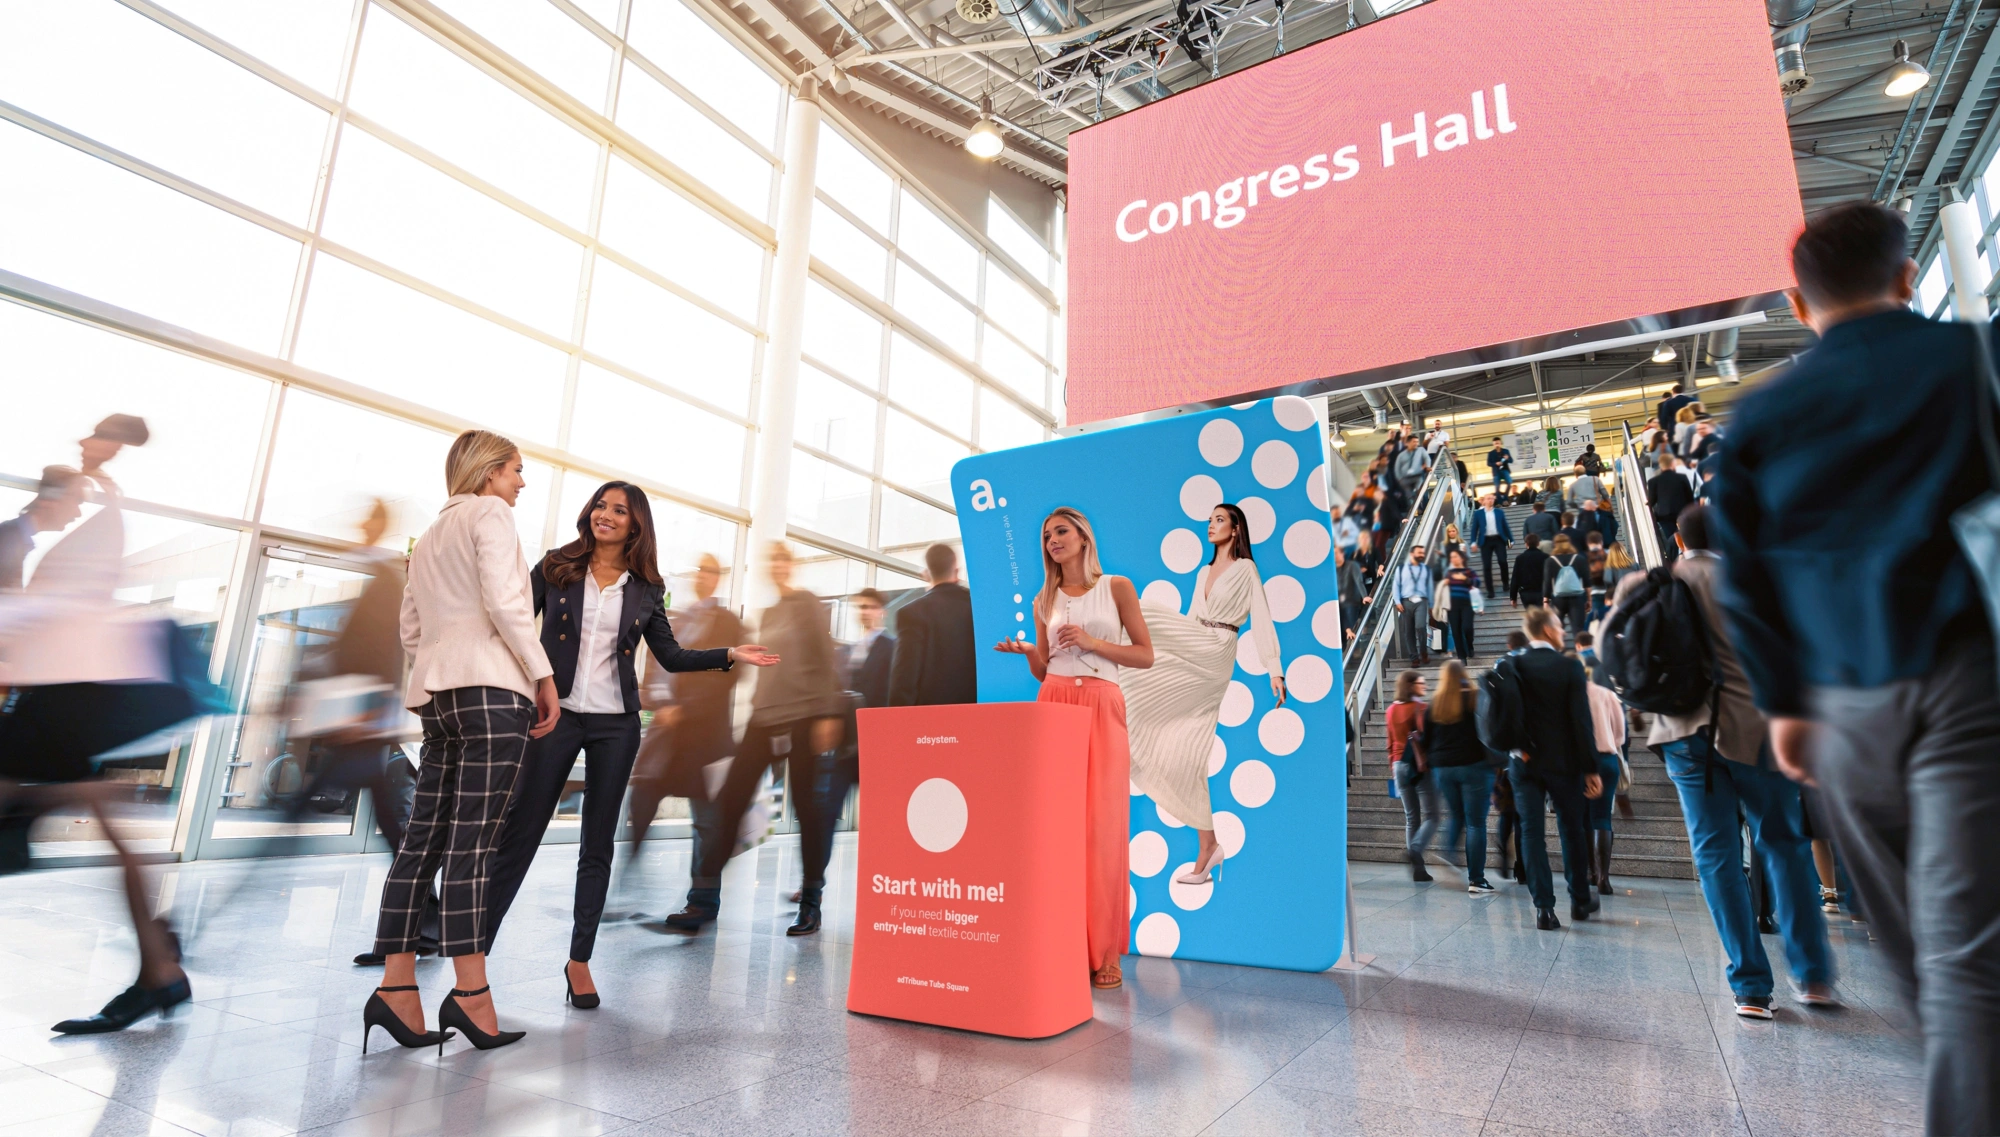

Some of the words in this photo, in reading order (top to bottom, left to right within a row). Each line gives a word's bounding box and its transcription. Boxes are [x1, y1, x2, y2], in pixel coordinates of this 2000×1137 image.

[1115, 143, 1360, 243] Congress
[1379, 83, 1518, 168] Hall
[1557, 428, 1562, 436] 1
[1572, 426, 1579, 435] 5
[1558, 437, 1570, 446] 10
[1580, 434, 1591, 443] 11
[970, 479, 1007, 512] a.
[1002, 514, 1011, 528] we
[1005, 529, 1014, 542] let
[1005, 542, 1016, 560] you
[1010, 561, 1020, 586] shine
[916, 735, 959, 745] adsystem.
[872, 873, 917, 896] Start
[921, 877, 961, 900] with
[967, 882, 1005, 903] me!
[890, 905, 898, 916] if
[899, 908, 916, 920] you
[918, 909, 943, 920] need
[945, 910, 978, 925] bigger
[873, 921, 926, 936] entry-level
[928, 925, 958, 939] textile
[960, 930, 1000, 942] counter
[897, 976, 928, 987] adTribune
[929, 979, 945, 989] Tube
[946, 982, 970, 993] Square
